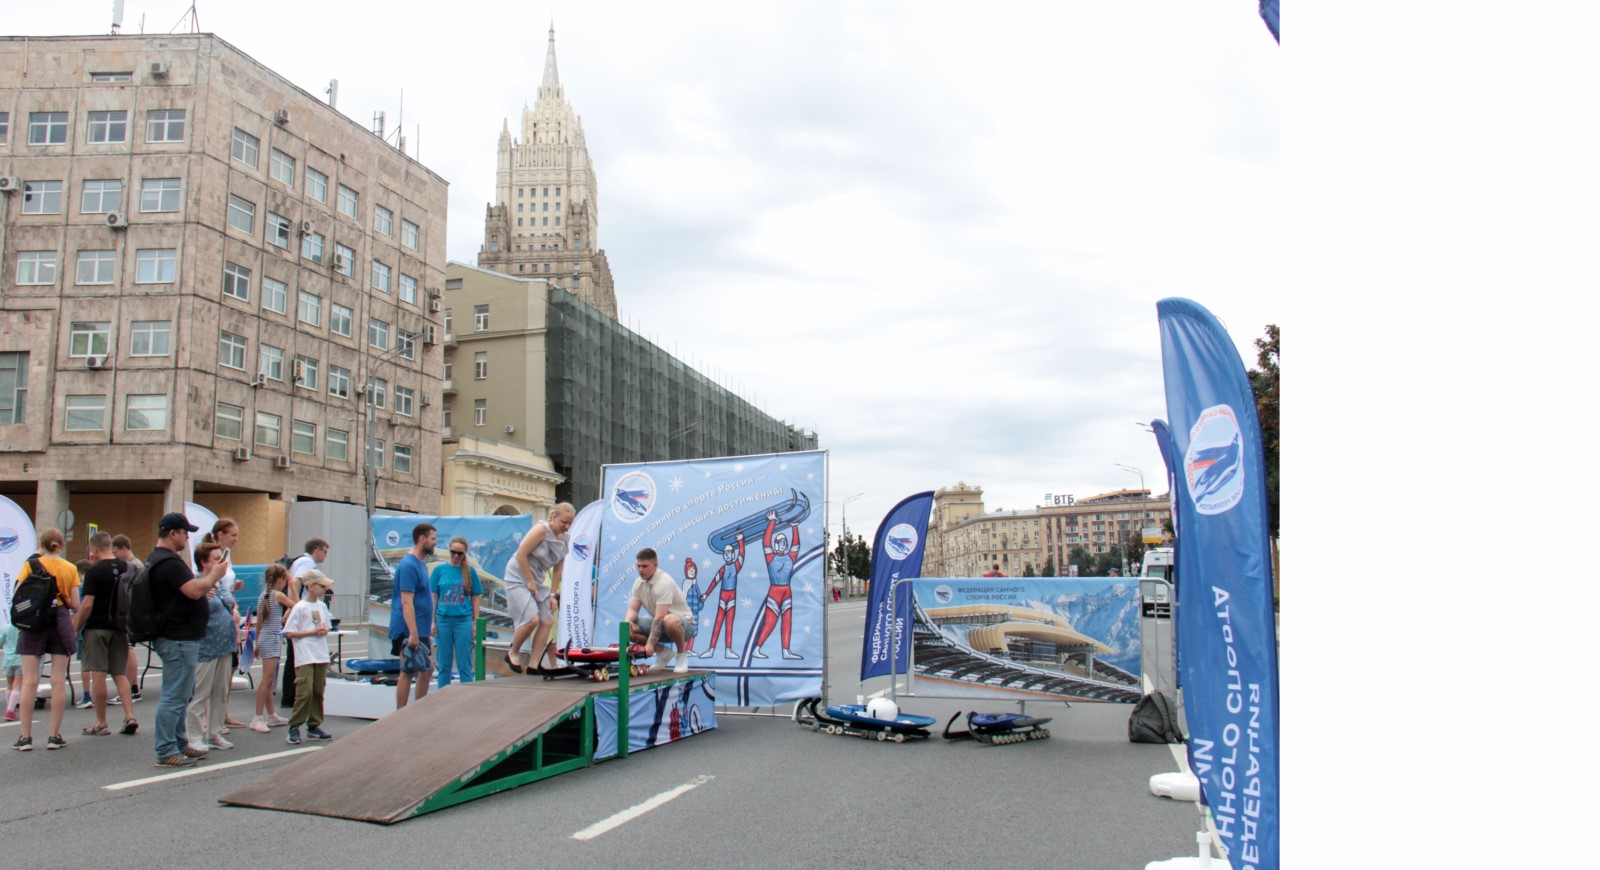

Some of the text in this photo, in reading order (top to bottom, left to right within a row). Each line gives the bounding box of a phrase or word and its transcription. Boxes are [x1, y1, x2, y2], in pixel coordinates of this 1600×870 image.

[646, 506, 682, 532] санного
[683, 489, 717, 510] спорта
[717, 478, 755, 493] России
[1054, 494, 1075, 505] ВТБ
[652, 529, 678, 551] спорт
[679, 509, 715, 533] высших
[717, 486, 784, 514] достижений!
[957, 586, 995, 594] ФЕДЕРАЦИЯ
[573, 617, 582, 648] АННОГО
